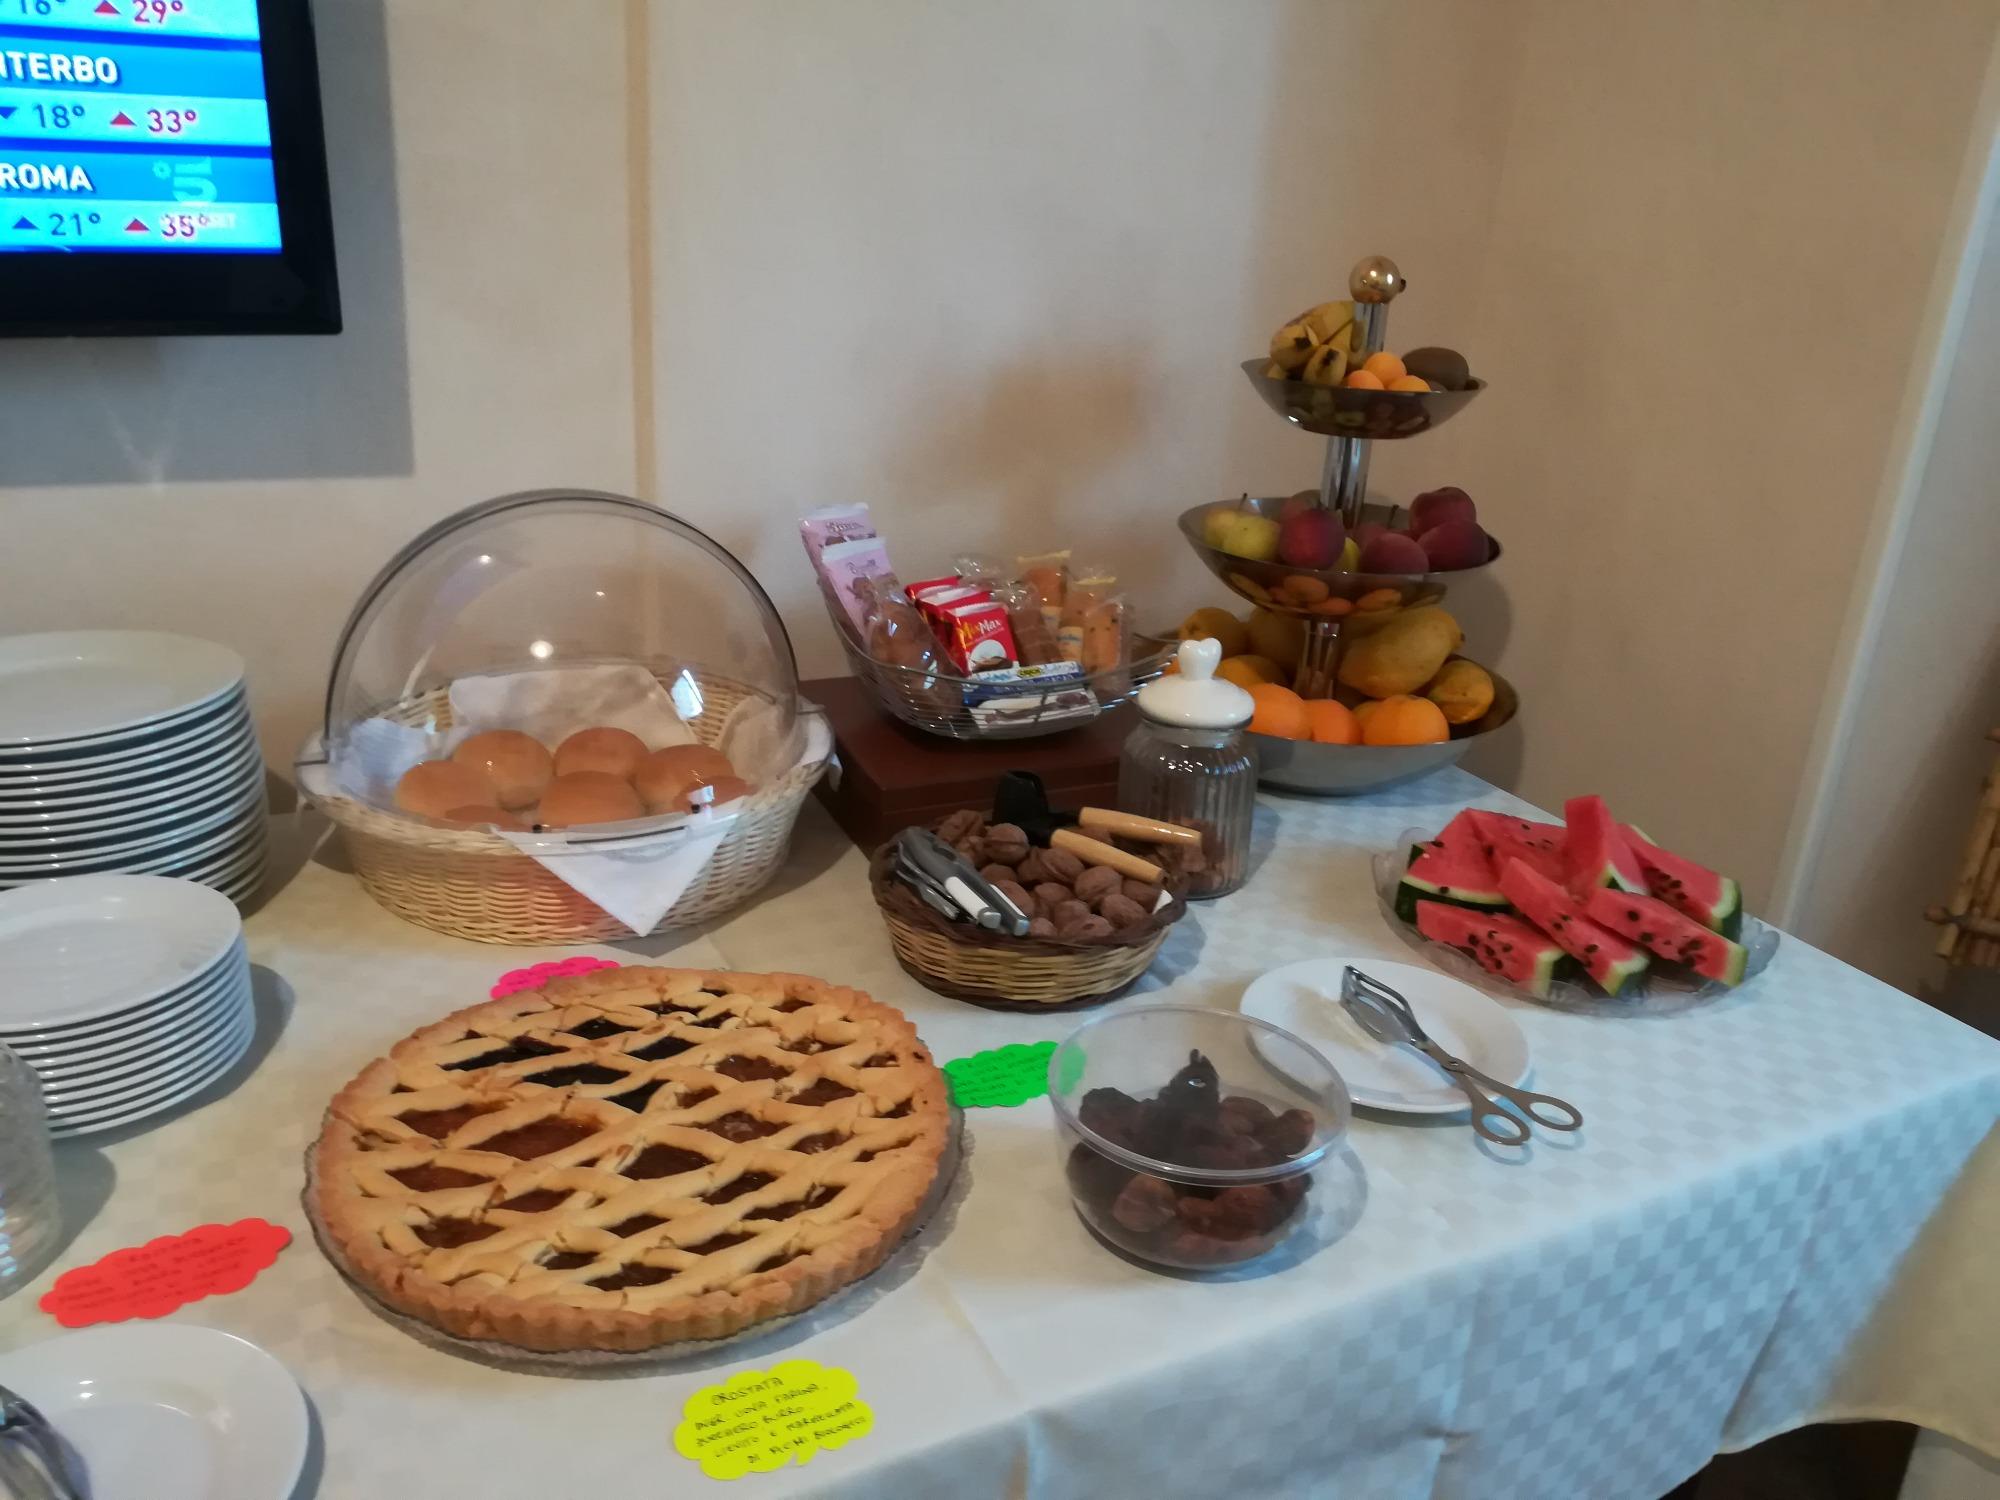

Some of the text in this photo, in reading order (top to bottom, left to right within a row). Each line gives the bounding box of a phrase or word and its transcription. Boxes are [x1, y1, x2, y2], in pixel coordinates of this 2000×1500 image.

[19, 0, 183, 23] 16 29°
[33, 104, 197, 133] 18° 33°
[0, 162, 94, 192] ROMA
[48, 212, 102, 236] 21°
[161, 213, 209, 237] 35°
